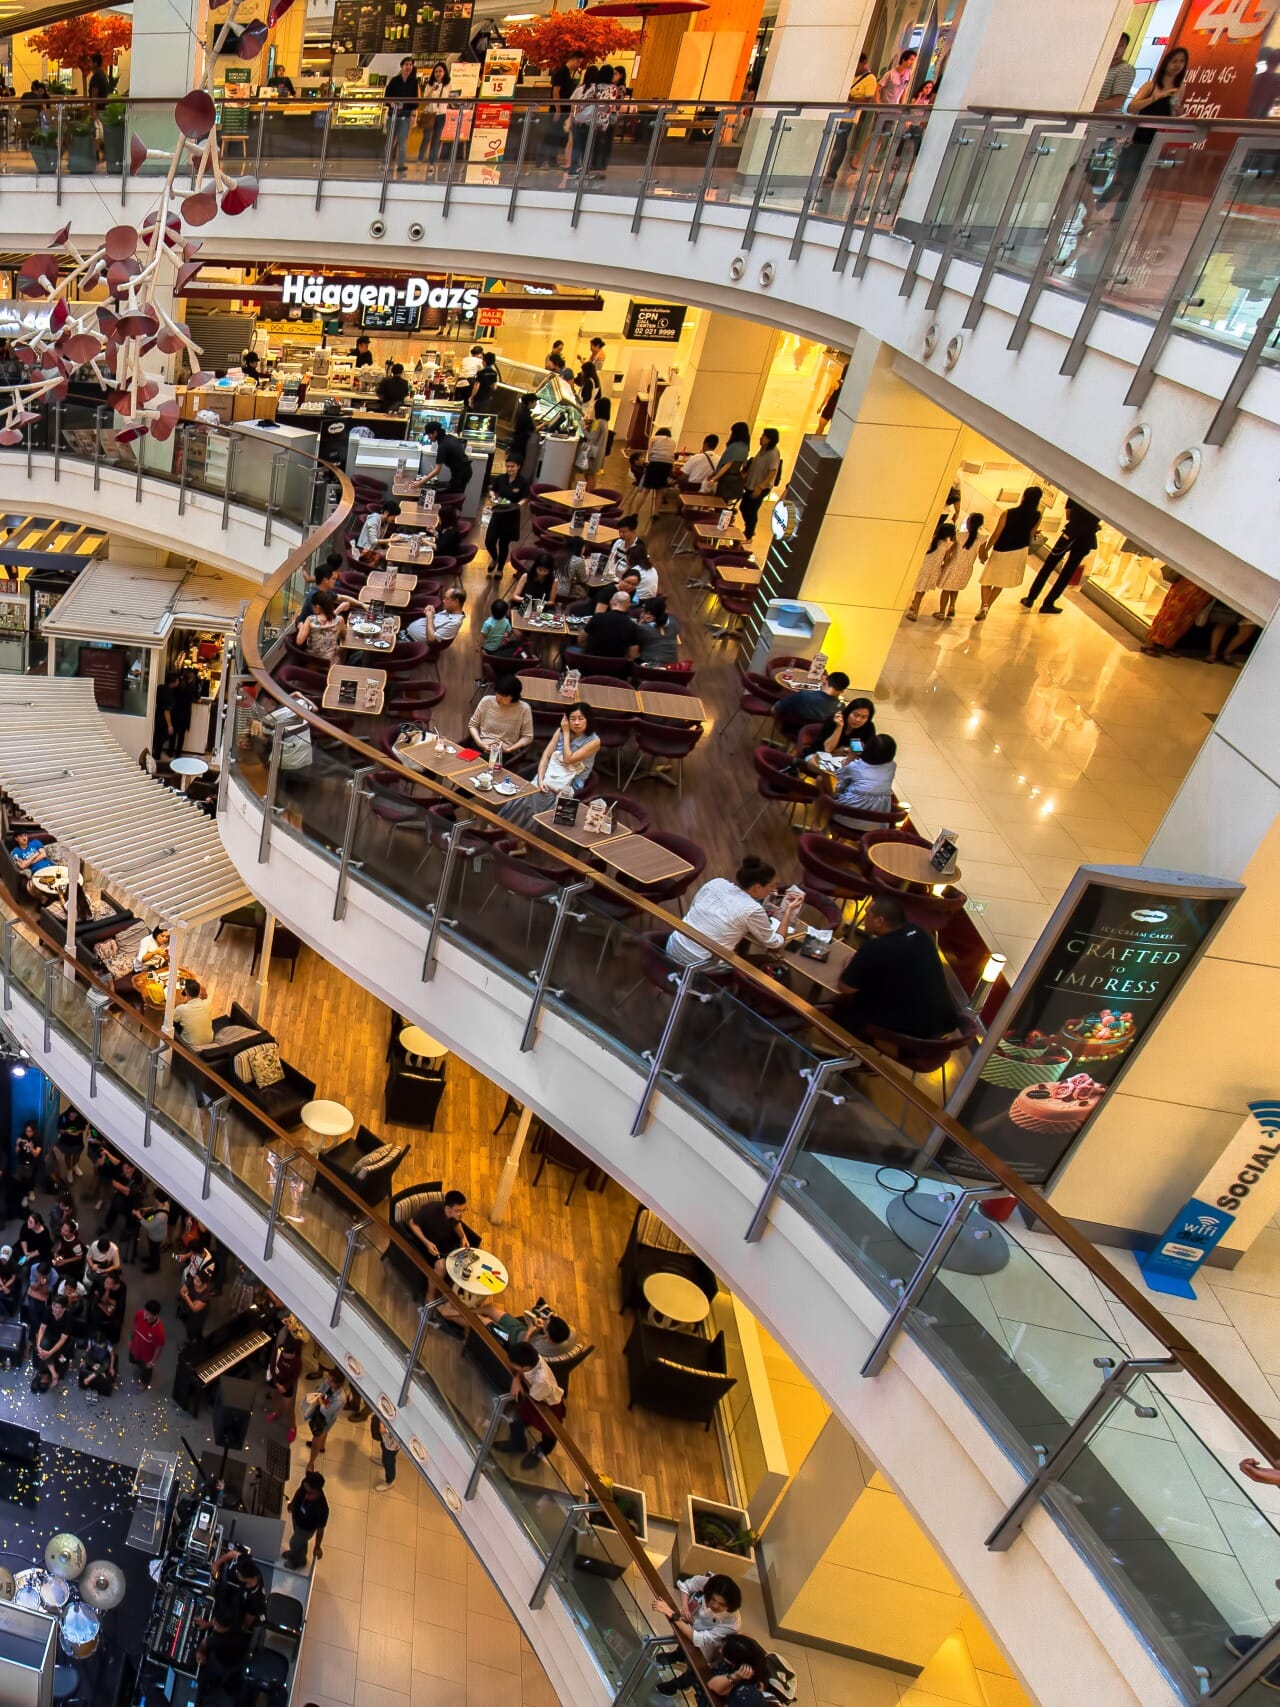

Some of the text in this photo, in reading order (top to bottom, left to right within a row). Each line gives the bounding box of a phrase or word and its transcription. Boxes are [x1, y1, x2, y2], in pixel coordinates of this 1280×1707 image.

[493, 82, 503, 93] 15
[282, 275, 479, 313] Häagen-Dazs
[638, 312, 659, 320] CPN
[1117, 928, 1147, 938] CREAM
[1148, 932, 1174, 941] CAKES
[1066, 939, 1181, 966] CRAFTED
[1110, 965, 1126, 973] TO
[1054, 969, 1160, 994] IMPRESS
[1216, 1143, 1280, 1212] SOCIAL
[1183, 1221, 1219, 1238] wifi
